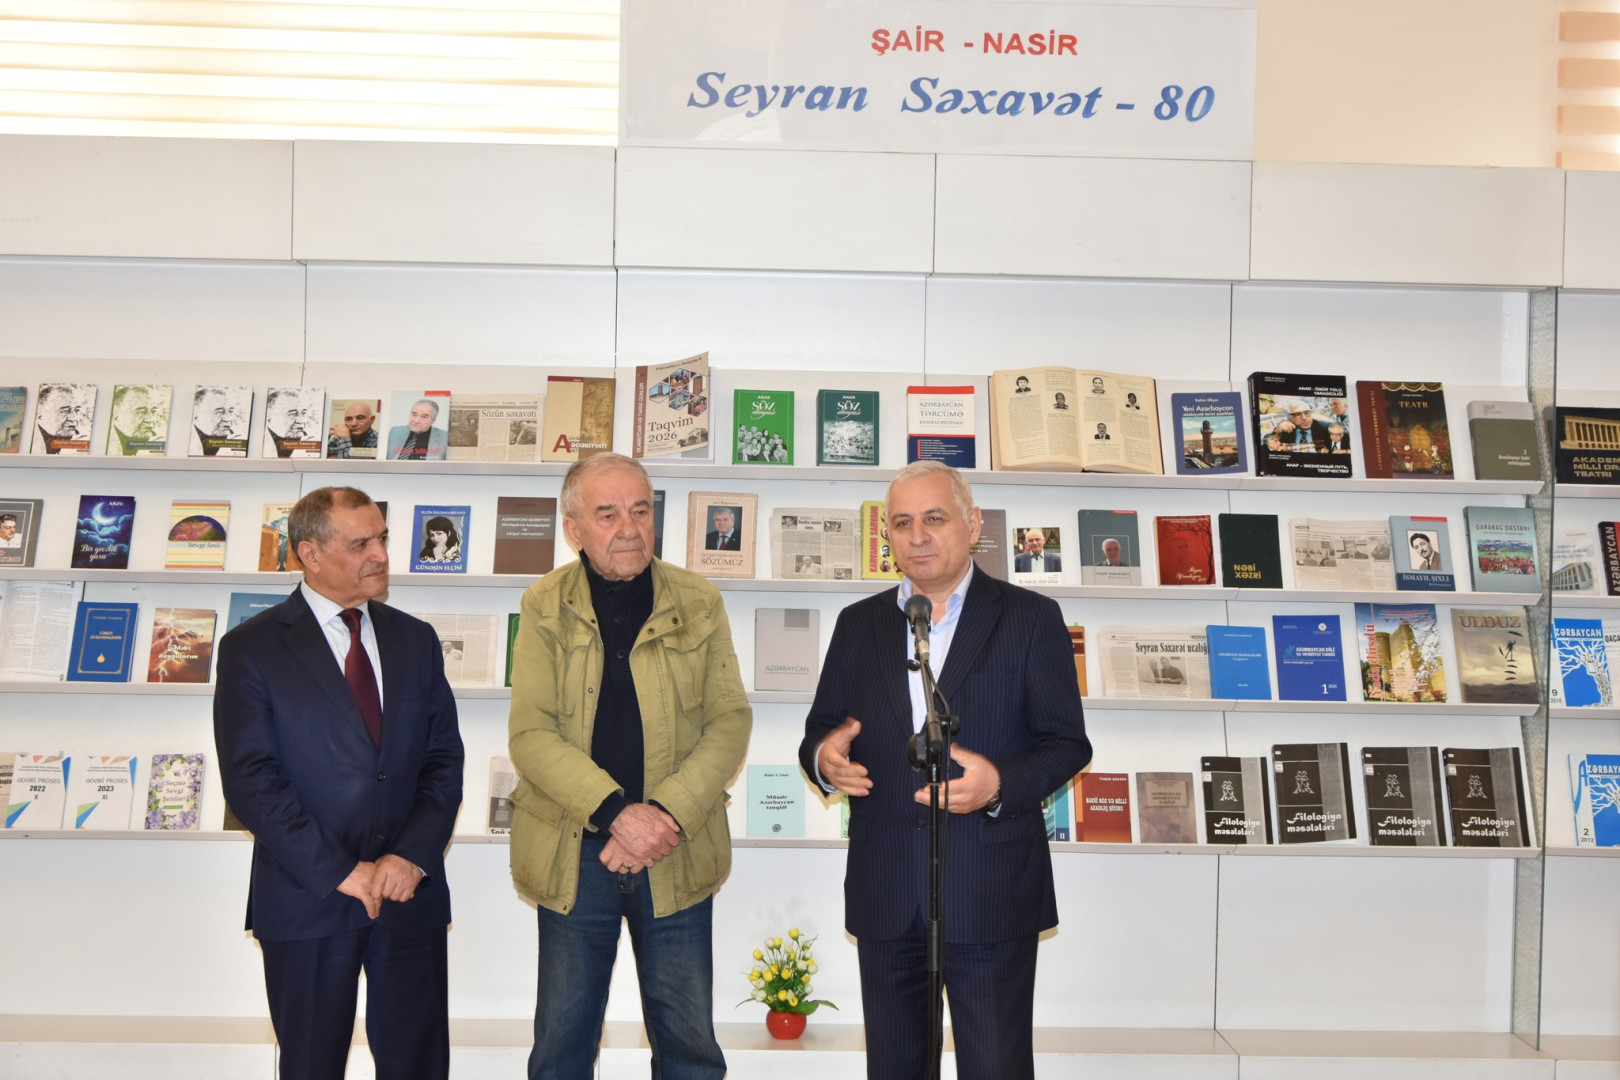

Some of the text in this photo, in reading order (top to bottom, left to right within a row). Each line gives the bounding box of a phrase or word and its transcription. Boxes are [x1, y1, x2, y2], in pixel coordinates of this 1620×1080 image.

[871, 25, 945, 55] ŞAİR
[983, 31, 1079, 56] NASİR
[687, 71, 868, 118] Seyran
[901, 76, 1104, 119] Səxavət
[1154, 85, 1216, 122] 80
[1398, 401, 1428, 409] TEATR
[481, 410, 537, 418] Sözün səxavəti
[648, 417, 694, 431] Təqvim
[649, 432, 678, 443] 2026
[1235, 571, 1262, 579] XƏZRİ
[1403, 574, 1430, 582] İSMAYIL
[1459, 615, 1521, 628] ULDUZ
[1136, 642, 1158, 654] Seyran
[1551, 688, 1558, 696] 9
[1214, 817, 1260, 828] Filologiya
[1286, 812, 1342, 825] Filologiya
[1377, 816, 1432, 827] Filologiya
[1461, 816, 1515, 828] Filologiya
[1583, 828, 1589, 836] 2
